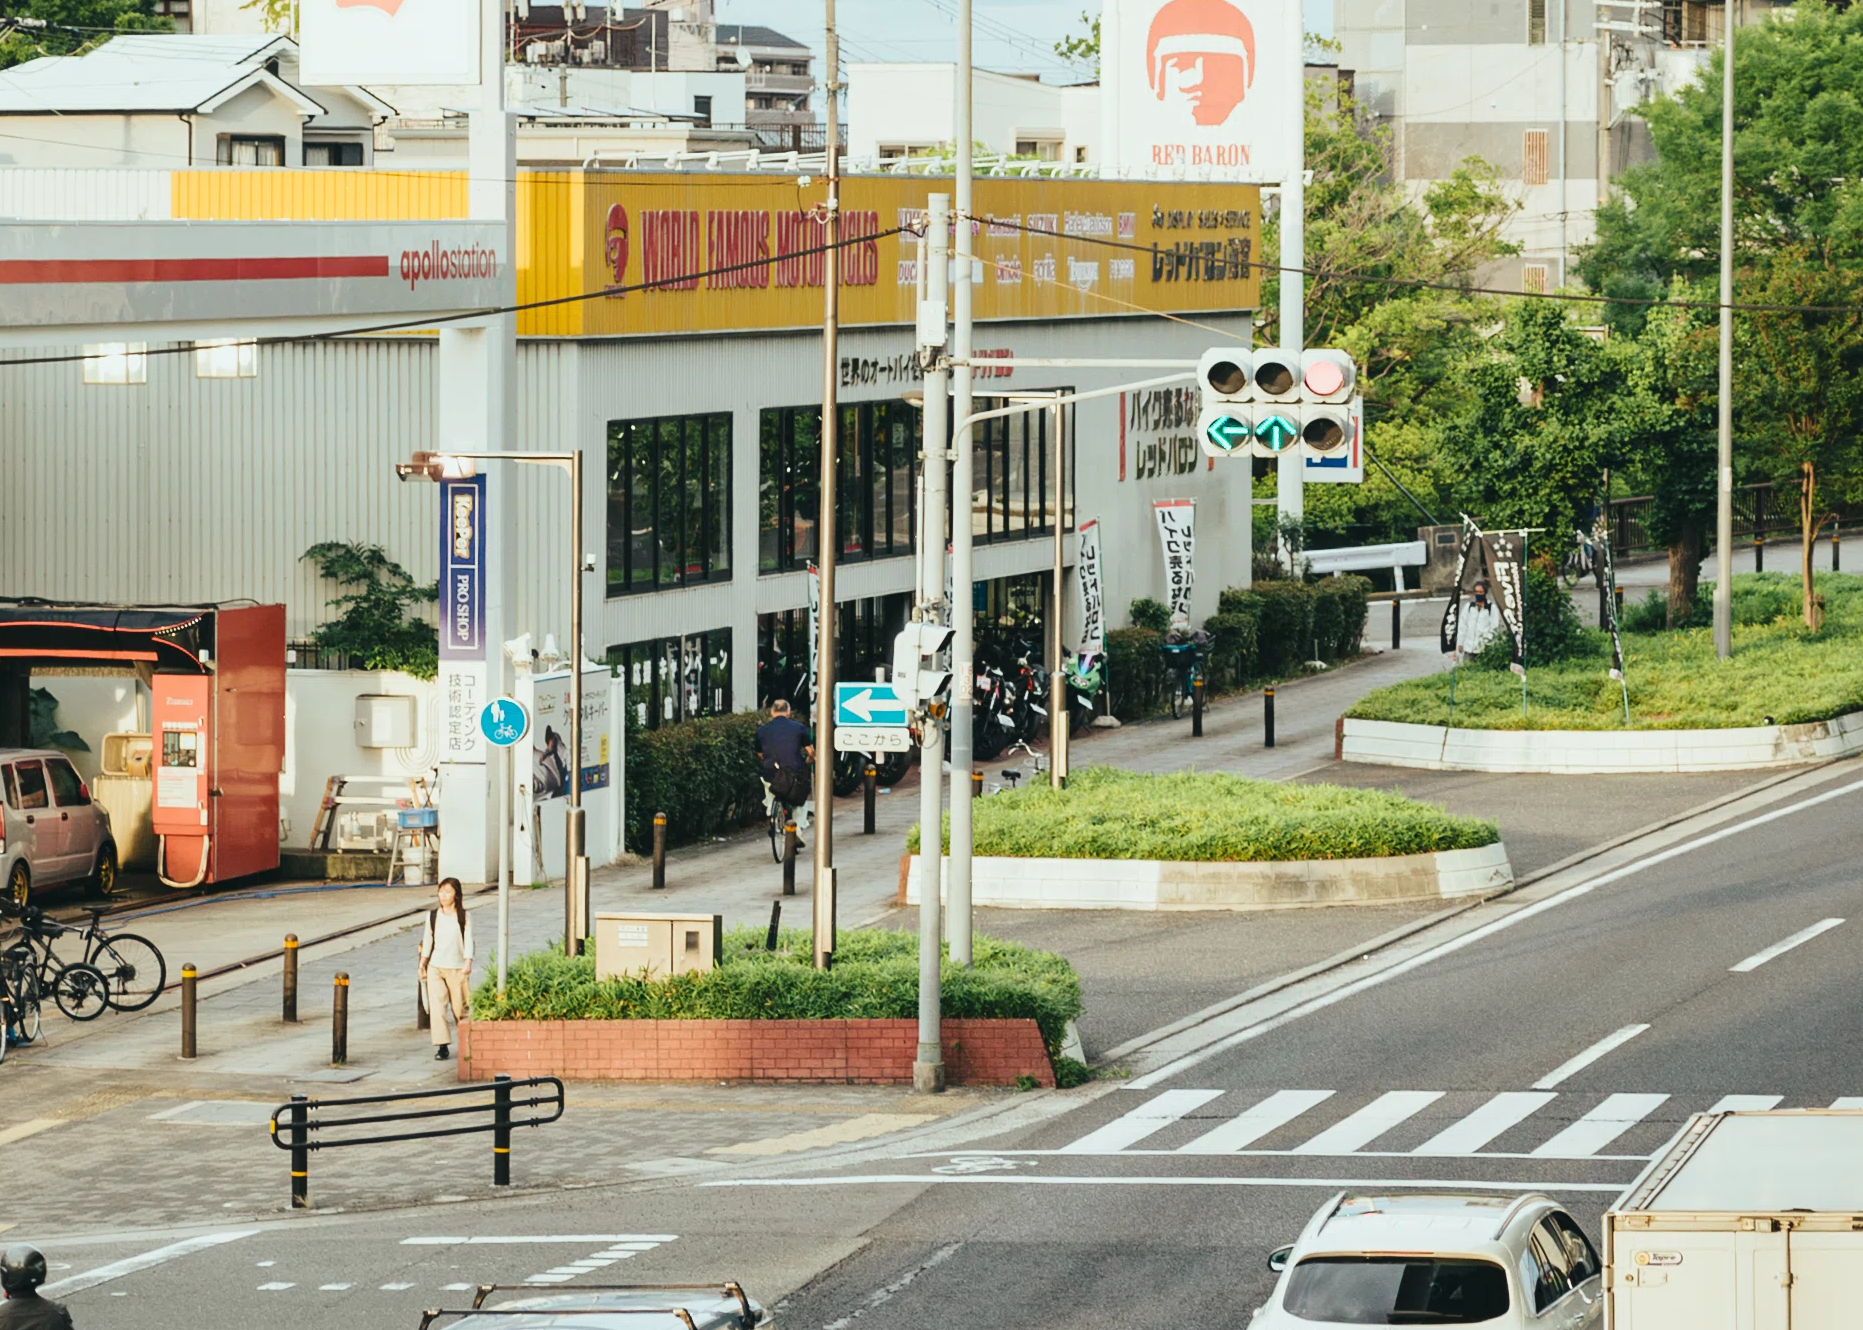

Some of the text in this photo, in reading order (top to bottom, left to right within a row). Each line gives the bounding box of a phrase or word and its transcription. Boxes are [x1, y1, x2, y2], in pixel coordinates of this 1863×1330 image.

[1192, 144, 1250, 166] BARON
[401, 240, 497, 291] apollostation
[641, 210, 699, 291] WORLD
[706, 210, 769, 289] FAMOUS
[1136, 437, 1198, 480] レッドバロン
[454, 494, 473, 559] KeePer
[456, 574, 469, 641] PRO SHOP
[448, 673, 462, 751] 技術認定店
[463, 674, 477, 752] コーティング
[842, 732, 902, 746] ここから
